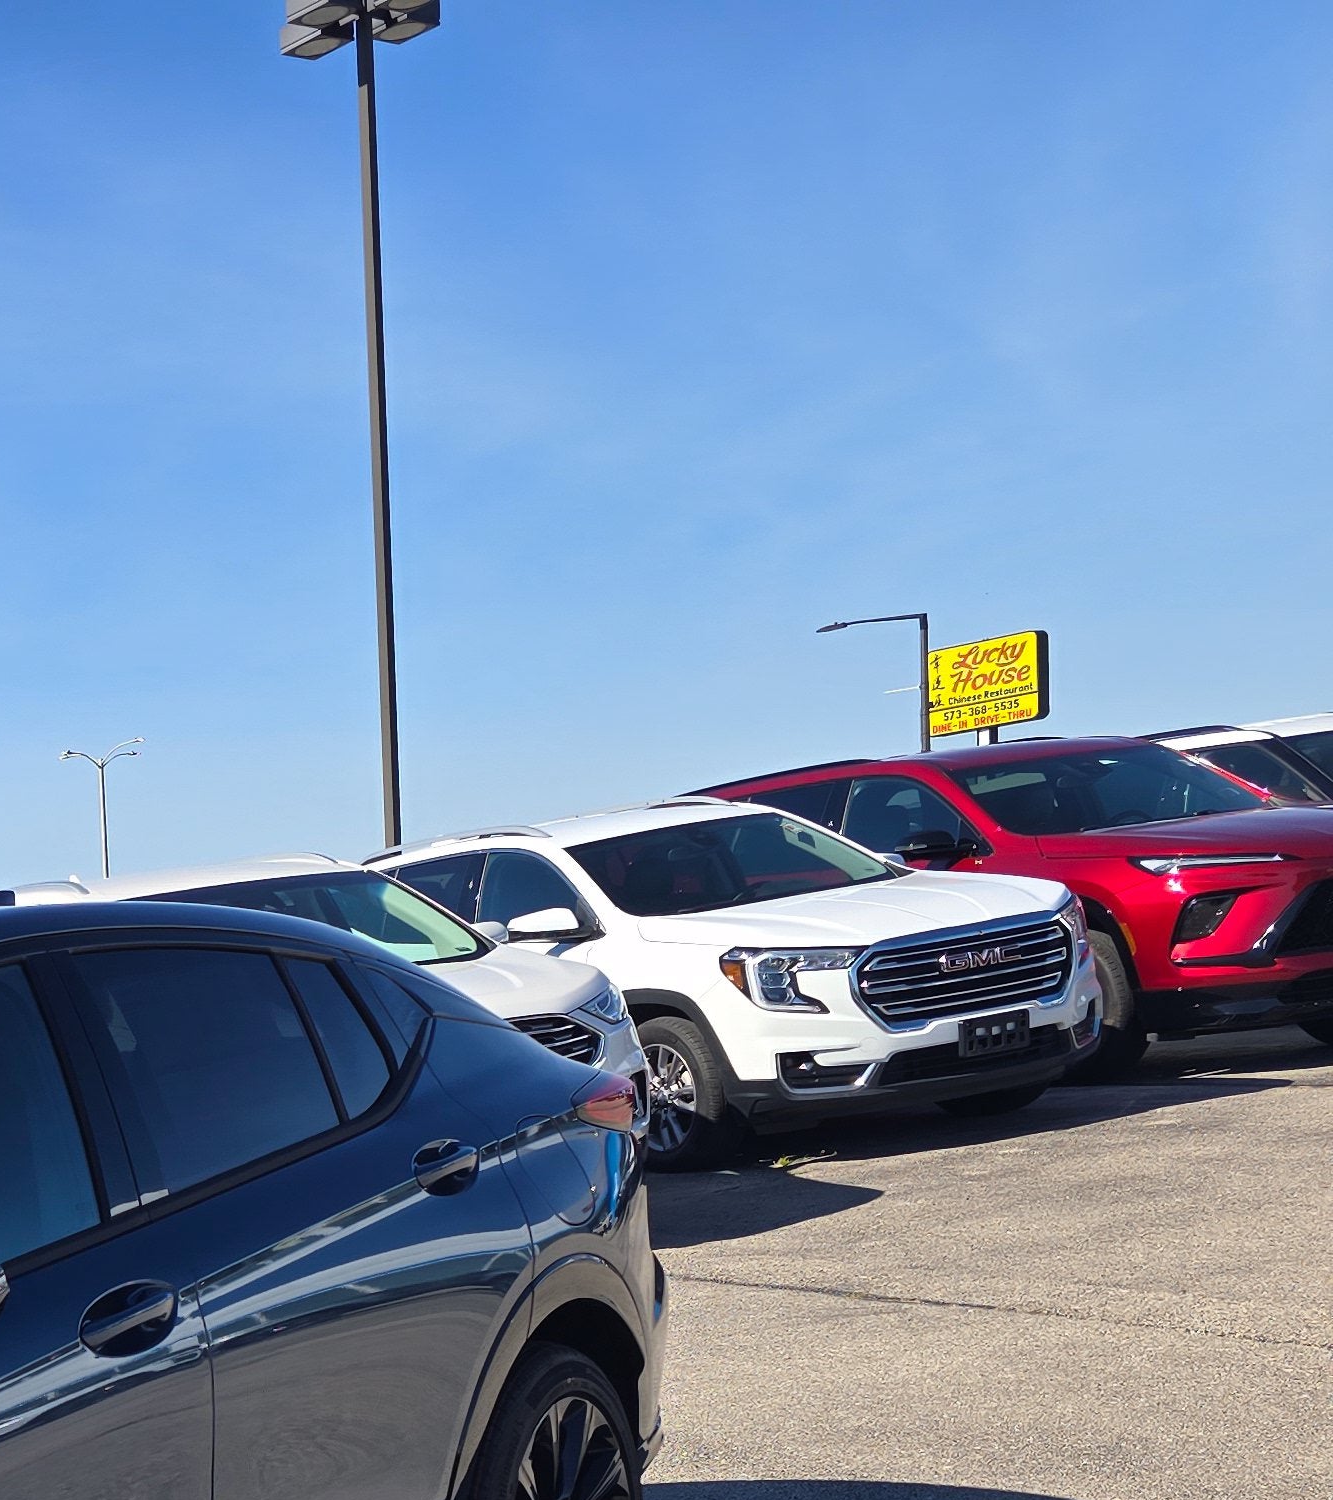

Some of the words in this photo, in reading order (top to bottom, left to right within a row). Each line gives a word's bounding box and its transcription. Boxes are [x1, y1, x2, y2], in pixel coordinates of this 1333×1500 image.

[952, 641, 1027, 669] Lucky
[950, 665, 1031, 693] House
[948, 693, 983, 705] Chinese
[984, 682, 1033, 699] Restaurant
[932, 720, 968, 734] DINE-IN
[974, 708, 1032, 726] DRIVE-THRU
[943, 699, 1020, 721] 573-368-5535
[939, 944, 1021, 972] GMC
